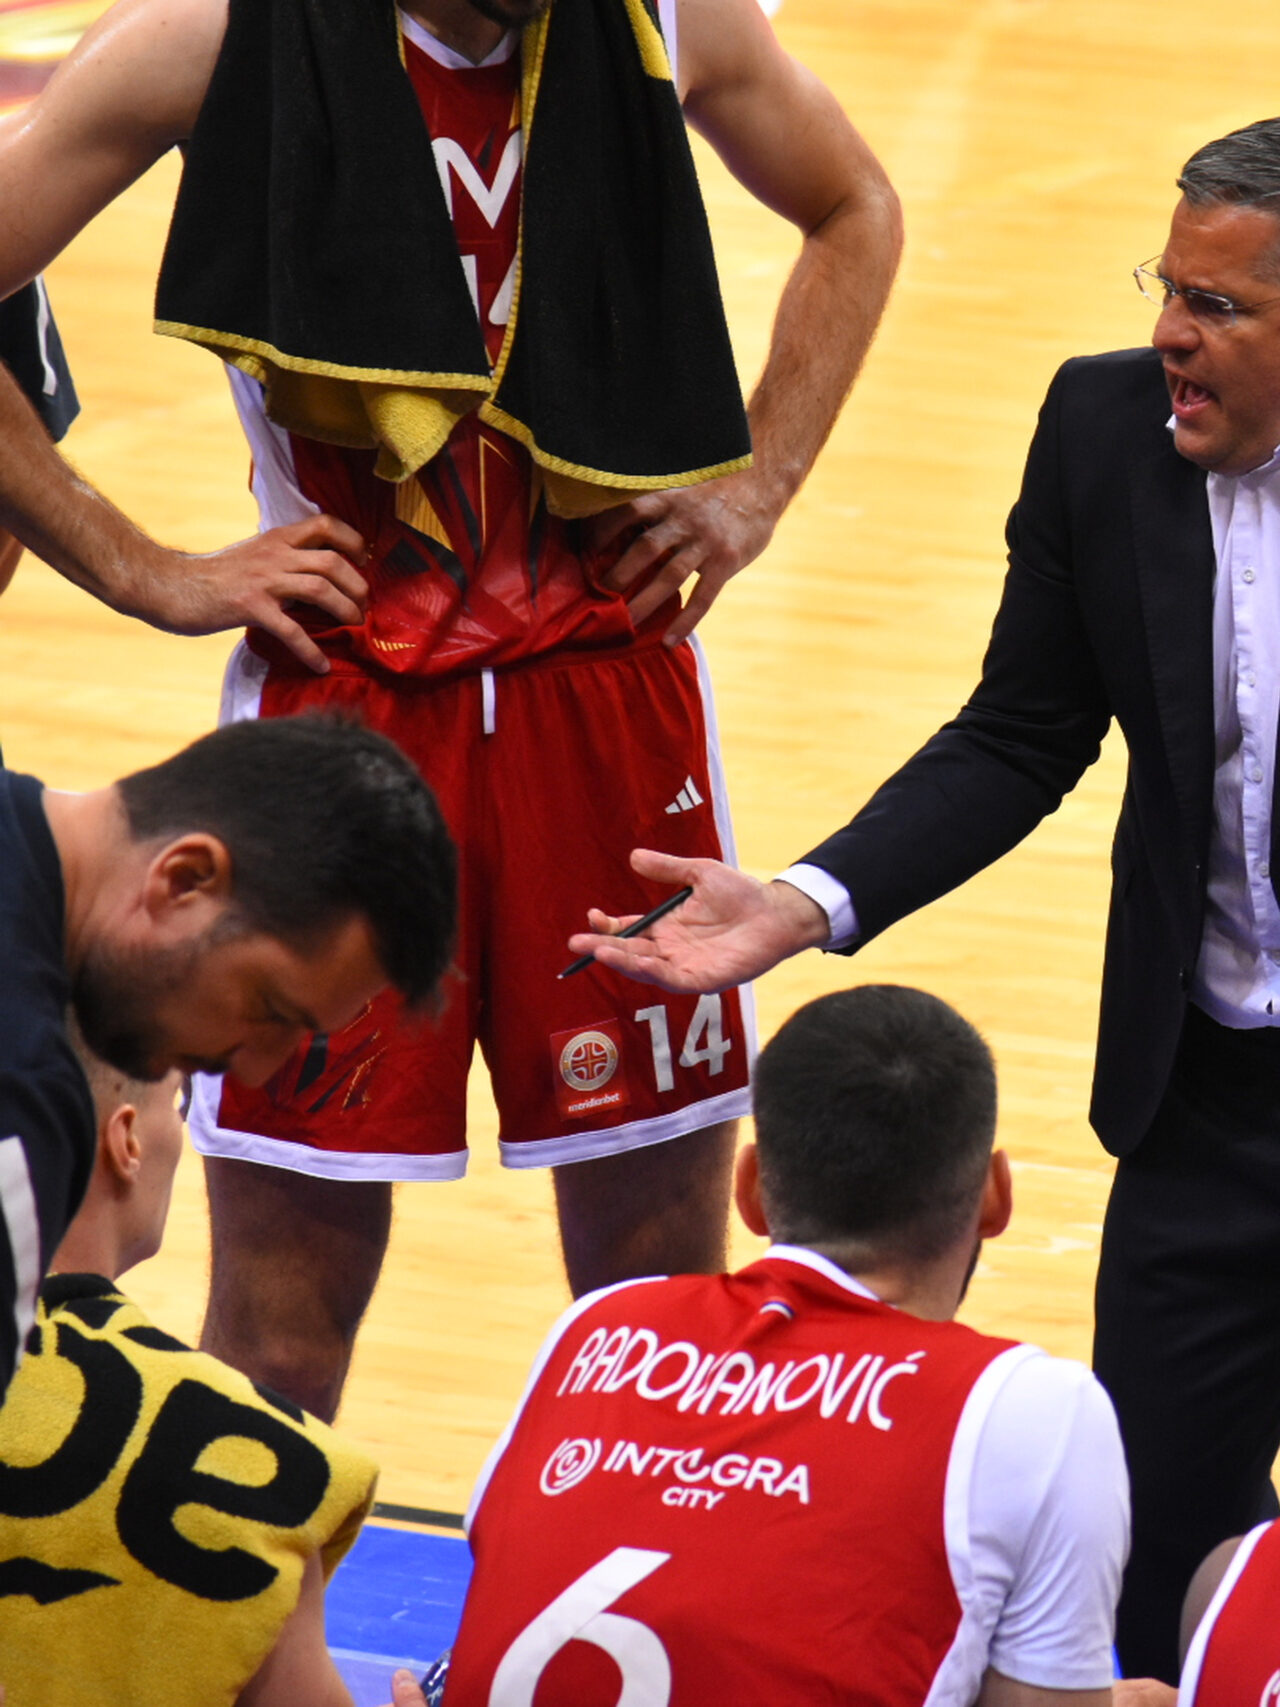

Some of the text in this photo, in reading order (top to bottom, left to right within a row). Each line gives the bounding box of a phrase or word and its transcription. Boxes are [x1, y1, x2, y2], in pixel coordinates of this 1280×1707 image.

[635, 992, 732, 1093] 14
[556, 1326, 926, 1430] RADOVANOVIĆ
[661, 1486, 726, 1510] CITY
[487, 1546, 672, 1707] 6
